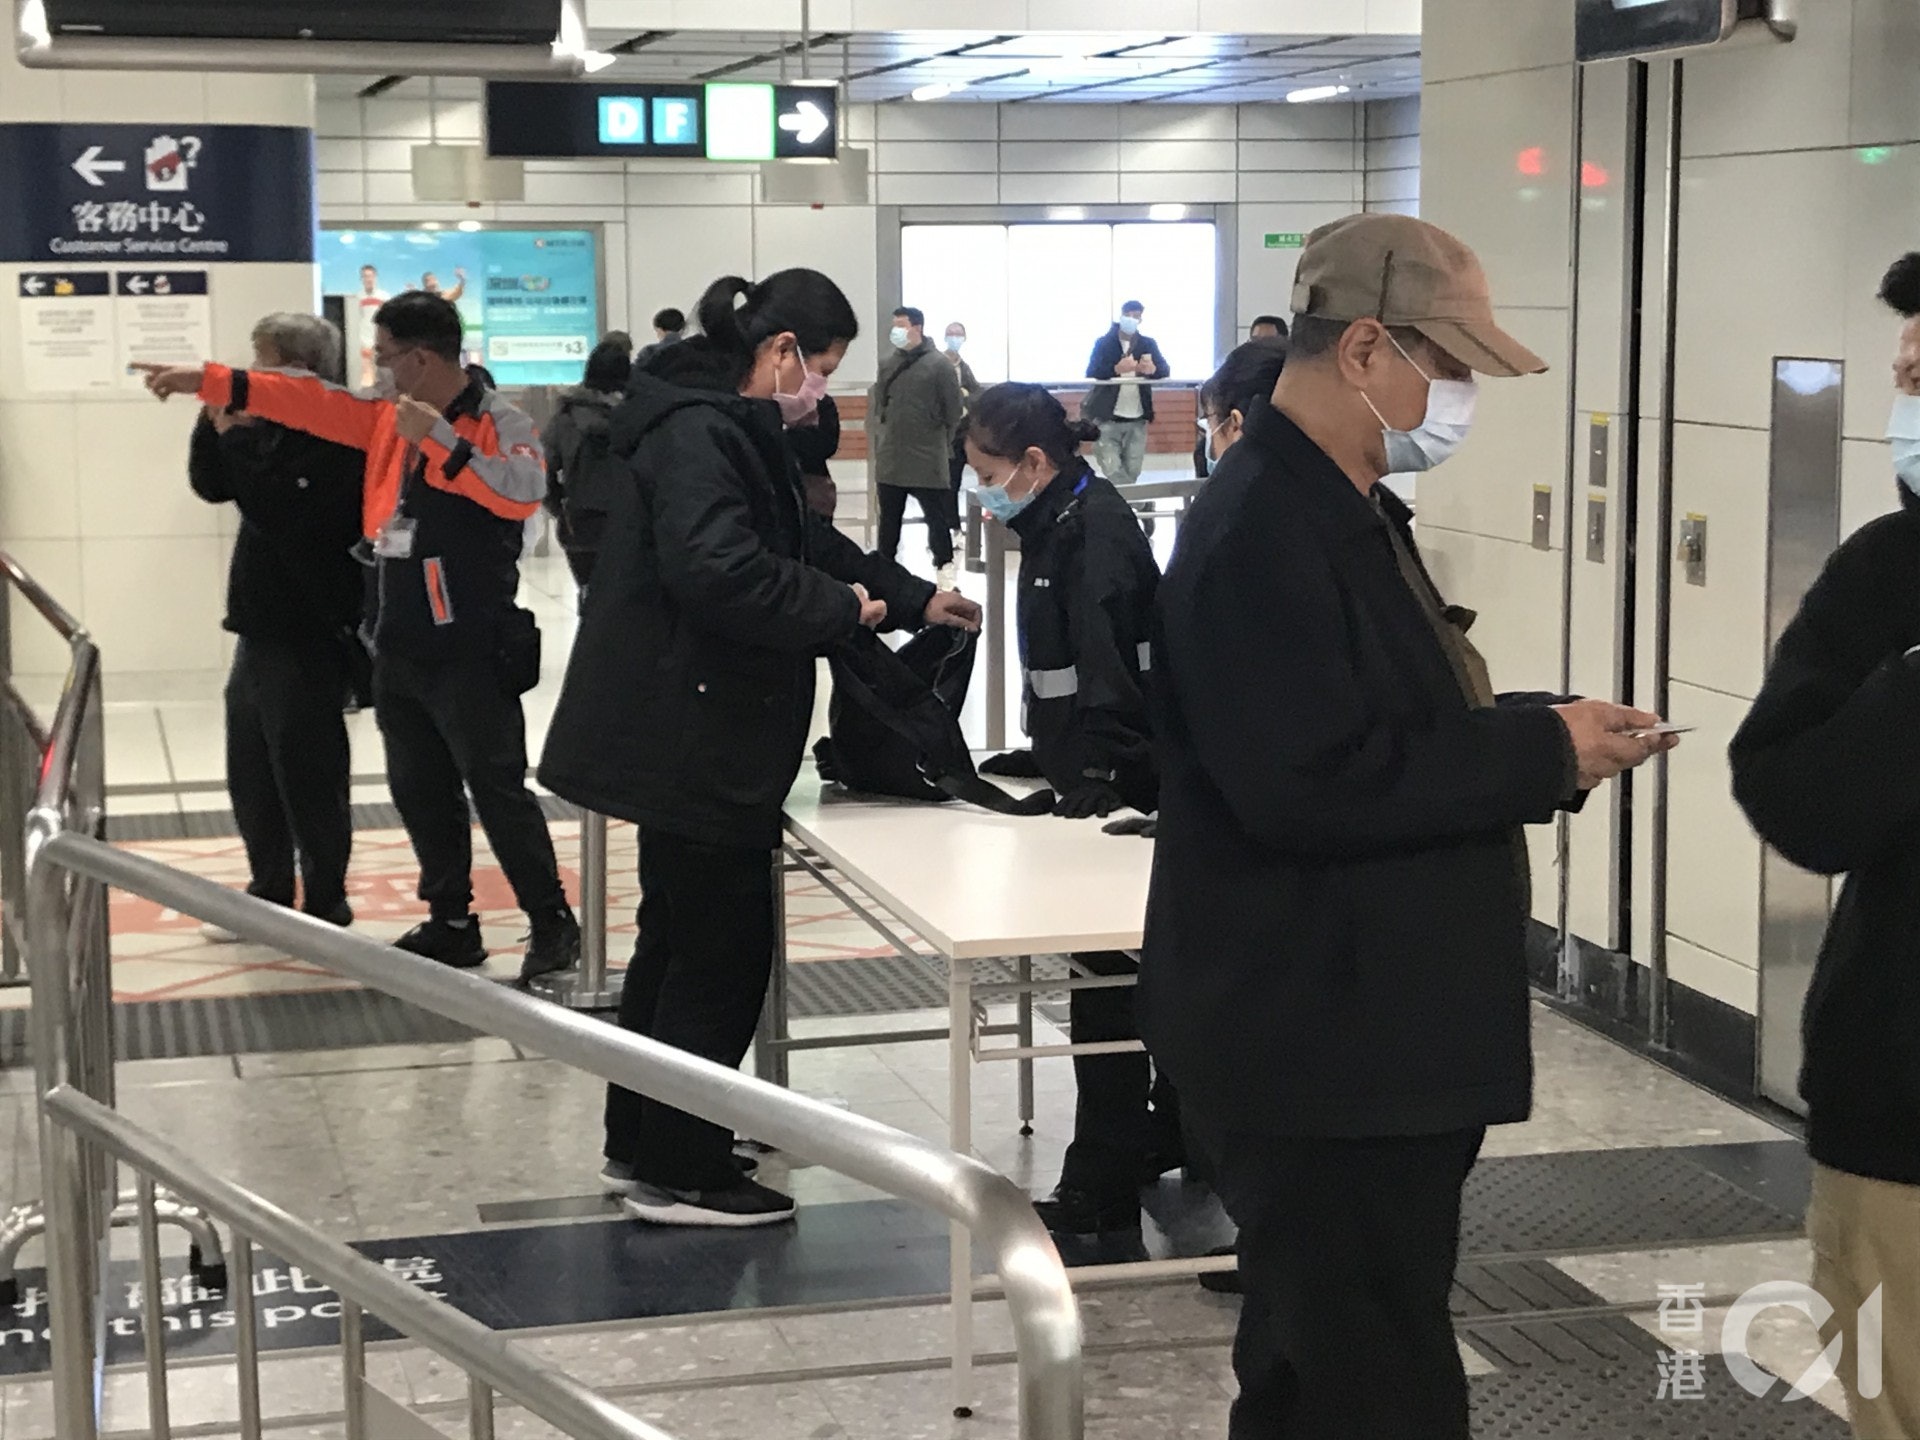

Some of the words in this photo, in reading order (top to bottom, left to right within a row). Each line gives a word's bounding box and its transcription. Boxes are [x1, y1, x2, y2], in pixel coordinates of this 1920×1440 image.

[607, 101, 639, 138] D
[664, 102, 689, 139] F
[72, 201, 205, 233] 客務中心
[49, 237, 122, 254] Customer
[123, 237, 176, 254] Service
[178, 237, 229, 254] Centre
